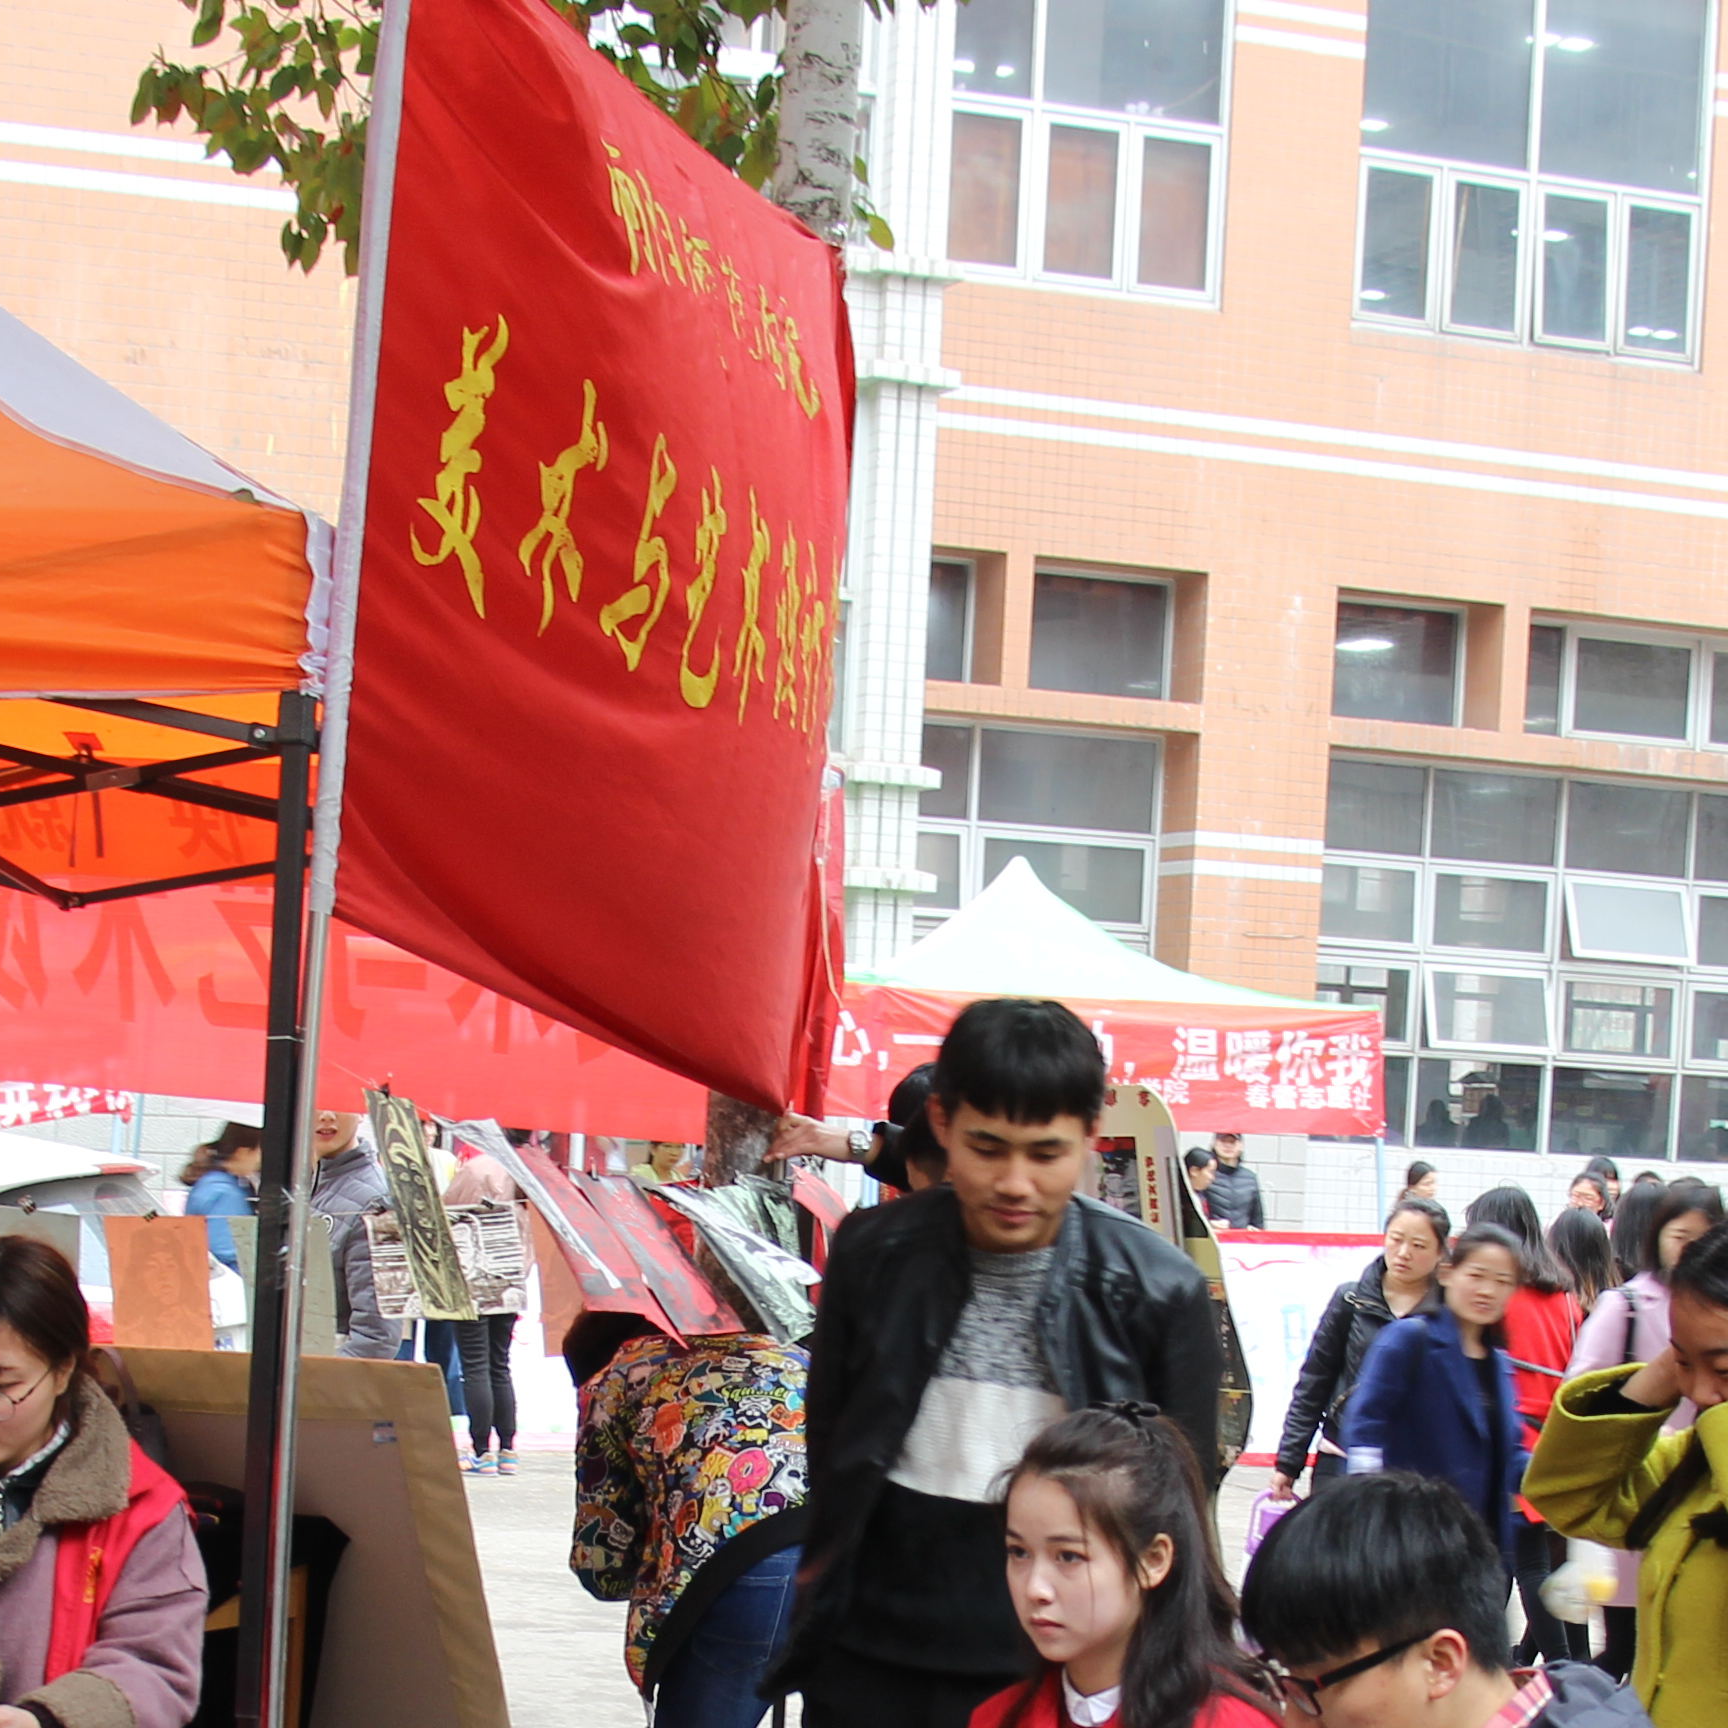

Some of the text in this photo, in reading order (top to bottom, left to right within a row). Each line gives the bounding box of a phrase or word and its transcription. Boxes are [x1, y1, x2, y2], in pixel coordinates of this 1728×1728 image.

[409, 313, 839, 748] 美术与艺术设计
